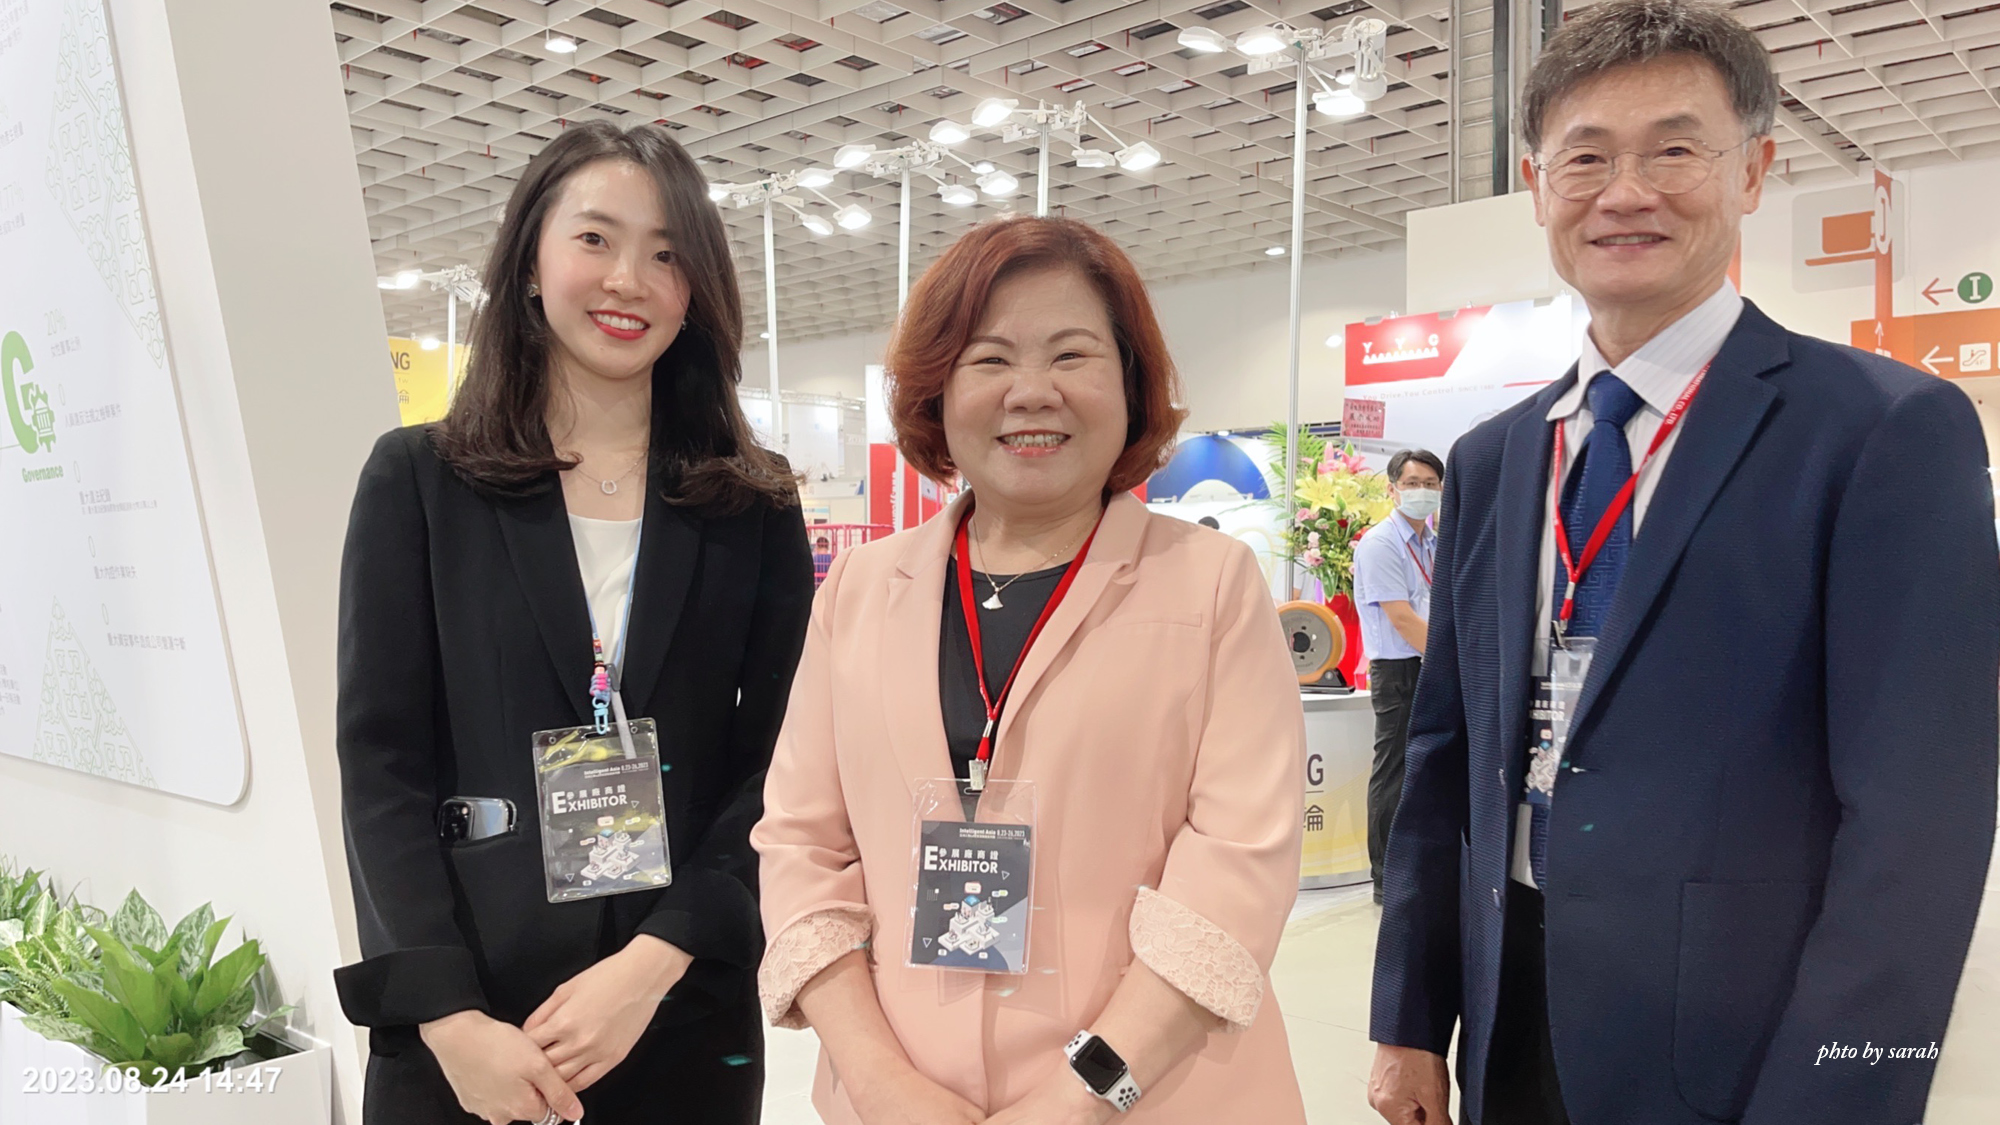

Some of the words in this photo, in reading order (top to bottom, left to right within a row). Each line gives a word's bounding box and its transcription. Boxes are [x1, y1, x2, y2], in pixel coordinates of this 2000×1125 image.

[1422, 387, 1454, 396] Control
[22, 464, 64, 483] Governance
[552, 790, 628, 814] EXHIBITOR
[924, 845, 998, 874] EXHIBITOR
